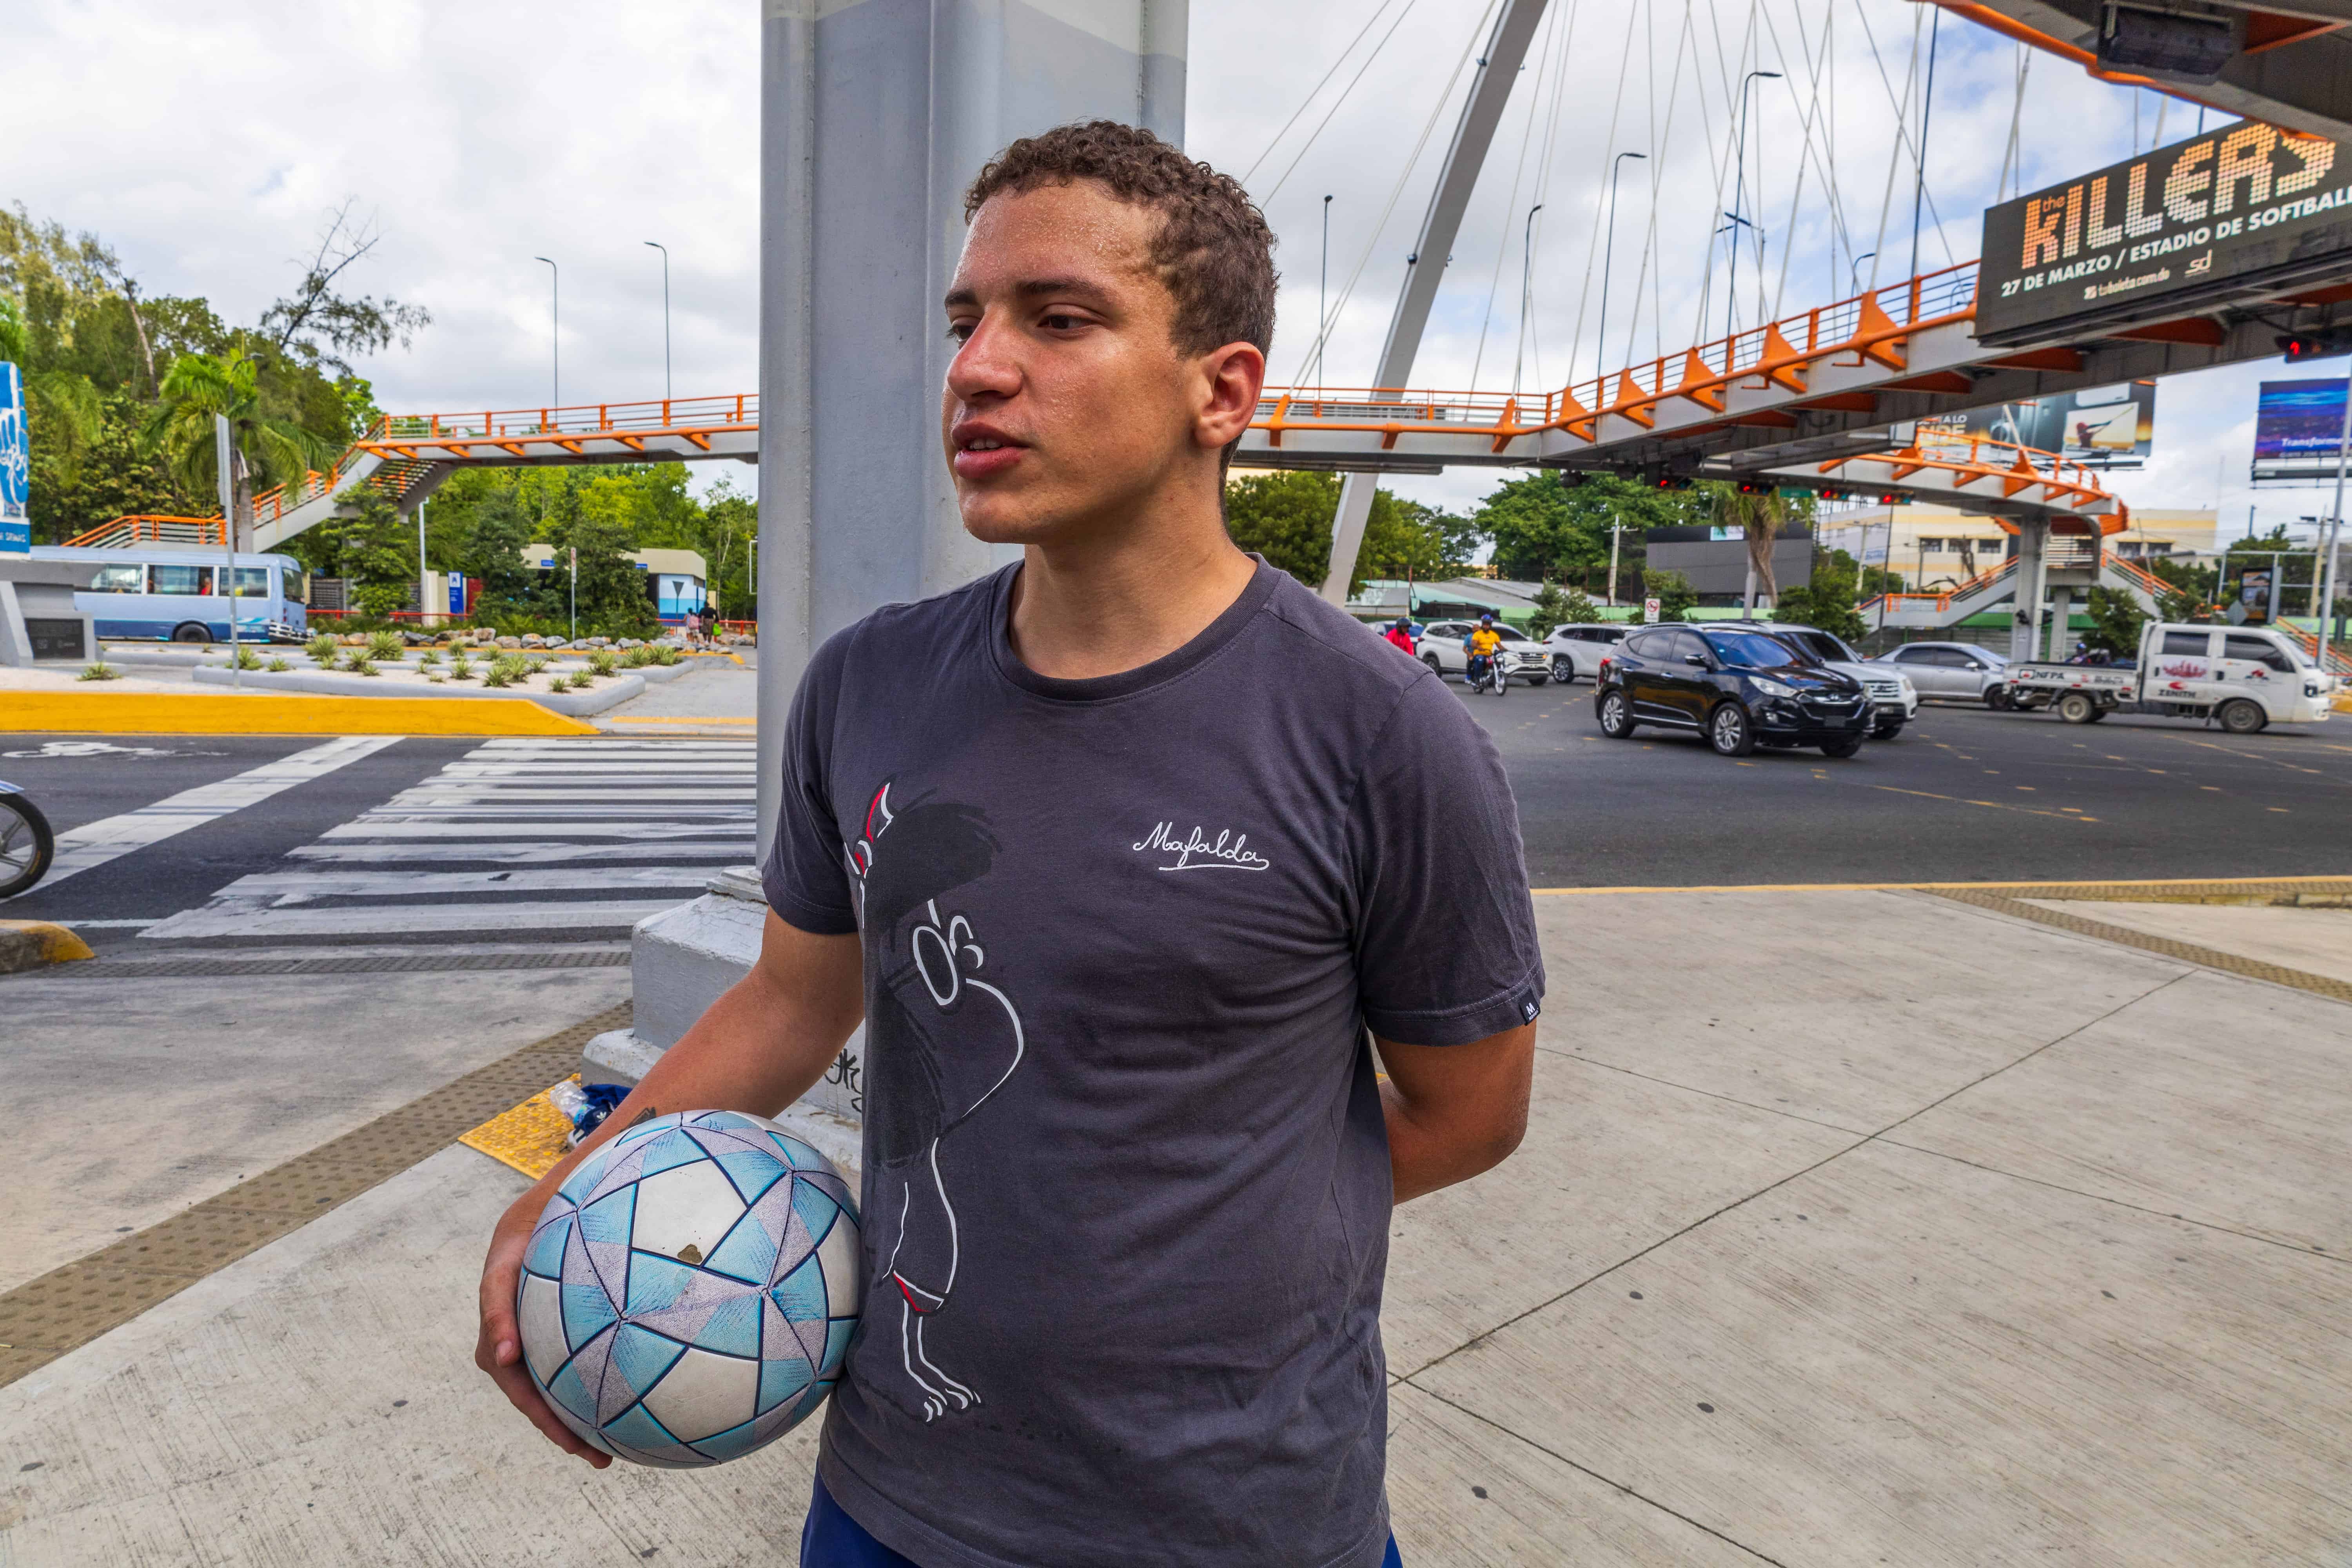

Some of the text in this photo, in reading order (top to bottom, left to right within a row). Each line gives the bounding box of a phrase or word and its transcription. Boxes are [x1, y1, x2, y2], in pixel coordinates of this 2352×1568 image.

[2042, 196, 2065, 212] the
[2001, 279, 2022, 297] 27
[2024, 272, 2045, 291] DE
[2047, 254, 2112, 285] MARZO
[2130, 227, 2211, 263] ESTADIO
[2216, 217, 2244, 240] DE
[2247, 185, 2352, 232] SOFTBALL
[1133, 822, 1266, 869] Mafalda
